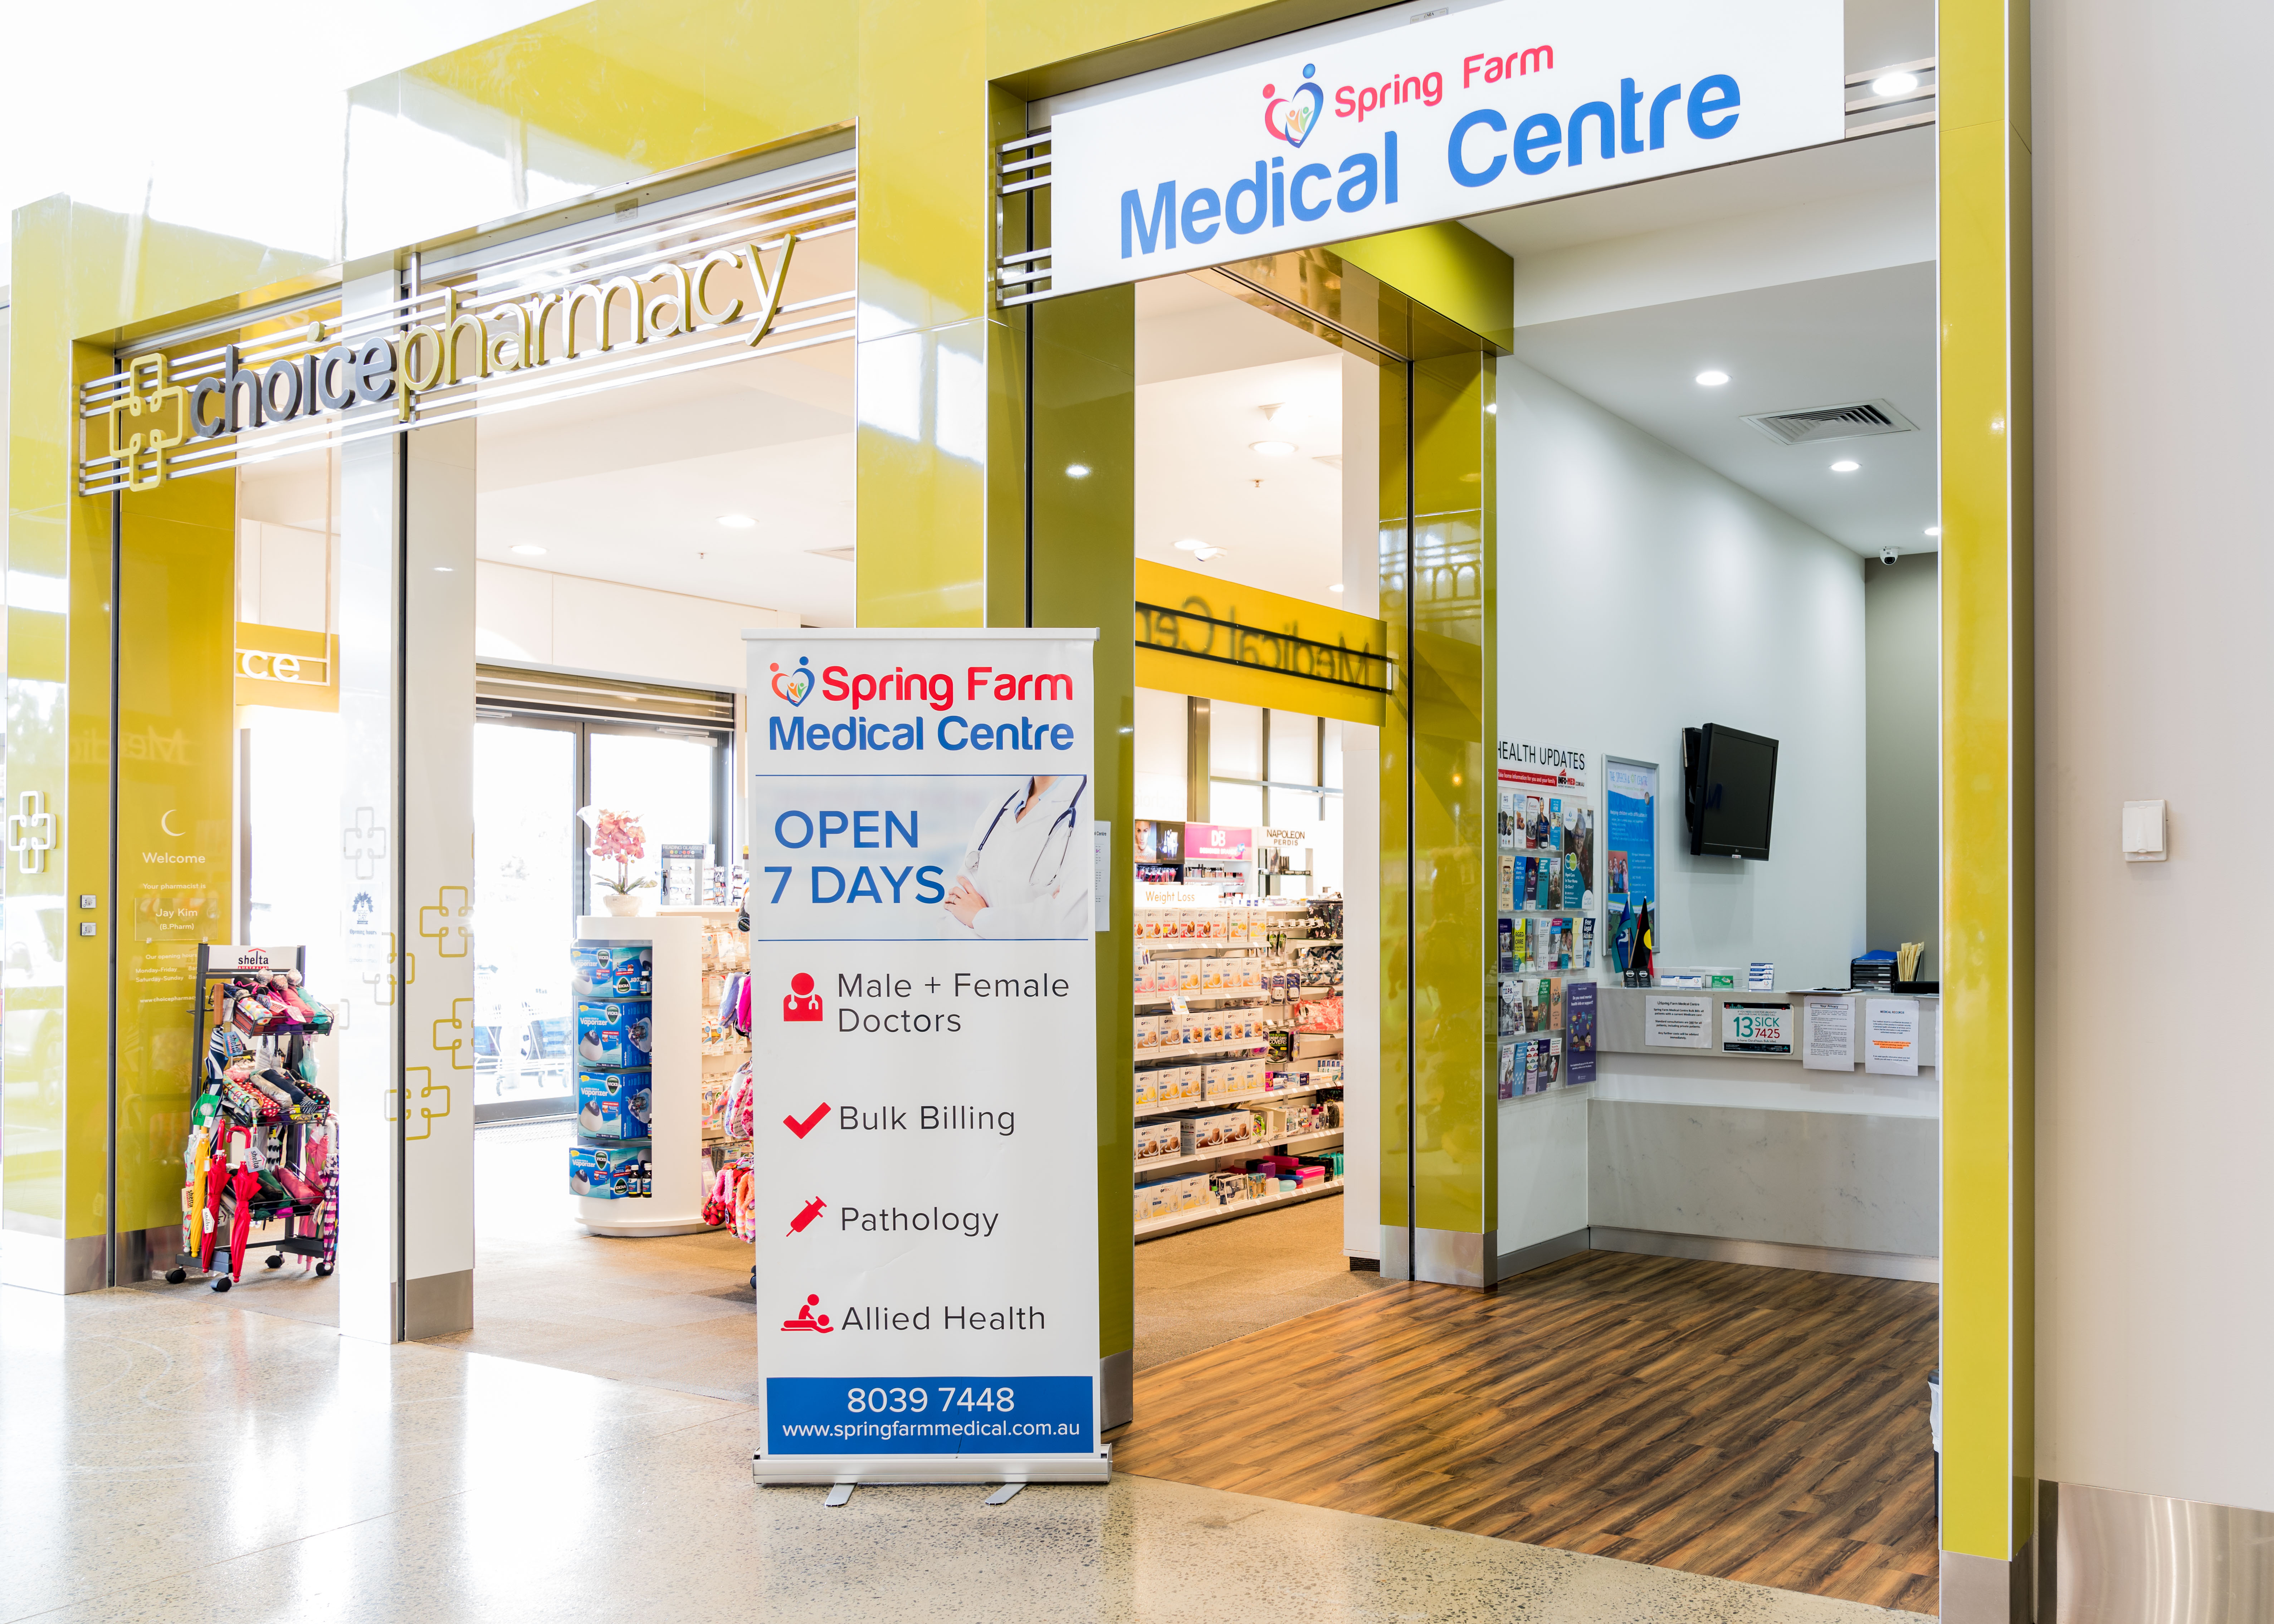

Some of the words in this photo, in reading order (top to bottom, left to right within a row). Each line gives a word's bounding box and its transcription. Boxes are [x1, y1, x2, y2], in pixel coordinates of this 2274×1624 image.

[1334, 65, 1444, 123] Spring
[1464, 44, 1554, 88] Farm
[1120, 130, 1399, 259] Medical
[1448, 73, 1742, 188] Centre
[823, 666, 953, 711] Spring
[967, 666, 1073, 700] Farm
[769, 716, 923, 750] Medical
[938, 716, 1074, 750] Centre
[1498, 741, 1536, 763] HEALTH
[1540, 747, 1585, 770] UPDATES
[1616, 772, 1626, 784] SPEECH
[1637, 776, 1648, 786] CENTRE
[775, 810, 918, 848] OPEN
[1211, 830, 1225, 847] DB
[1267, 830, 1305, 839] NAPOLEON
[142, 852, 205, 863] Welcome
[765, 866, 792, 904] 7
[812, 866, 945, 904] DAYS
[1146, 891, 1175, 904] Weight
[1178, 891, 1195, 901] Loss
[156, 909, 174, 918] Jay
[238, 951, 269, 964] shelta
[838, 973, 912, 998] Male
[925, 976, 941, 994] +
[955, 973, 1069, 997] Female
[580, 1018, 608, 1027] Vaporizer
[839, 1008, 961, 1033] Doctors
[1733, 1016, 1753, 1037] 13
[1755, 1017, 1780, 1027] SICK
[1755, 1028, 1780, 1038] 7425
[581, 1088, 608, 1097] Vaporizer
[840, 1106, 907, 1130] Bulk
[921, 1106, 1015, 1136] Billing
[572, 1159, 595, 1168] Vaporizer
[842, 1207, 999, 1237] Pathology
[841, 1306, 929, 1330] Allied
[945, 1306, 1044, 1330] Health
[848, 1388, 928, 1413] 8039
[938, 1387, 1015, 1412] 7448
[783, 1420, 1080, 1440] www.springfarmmedical.com.au
